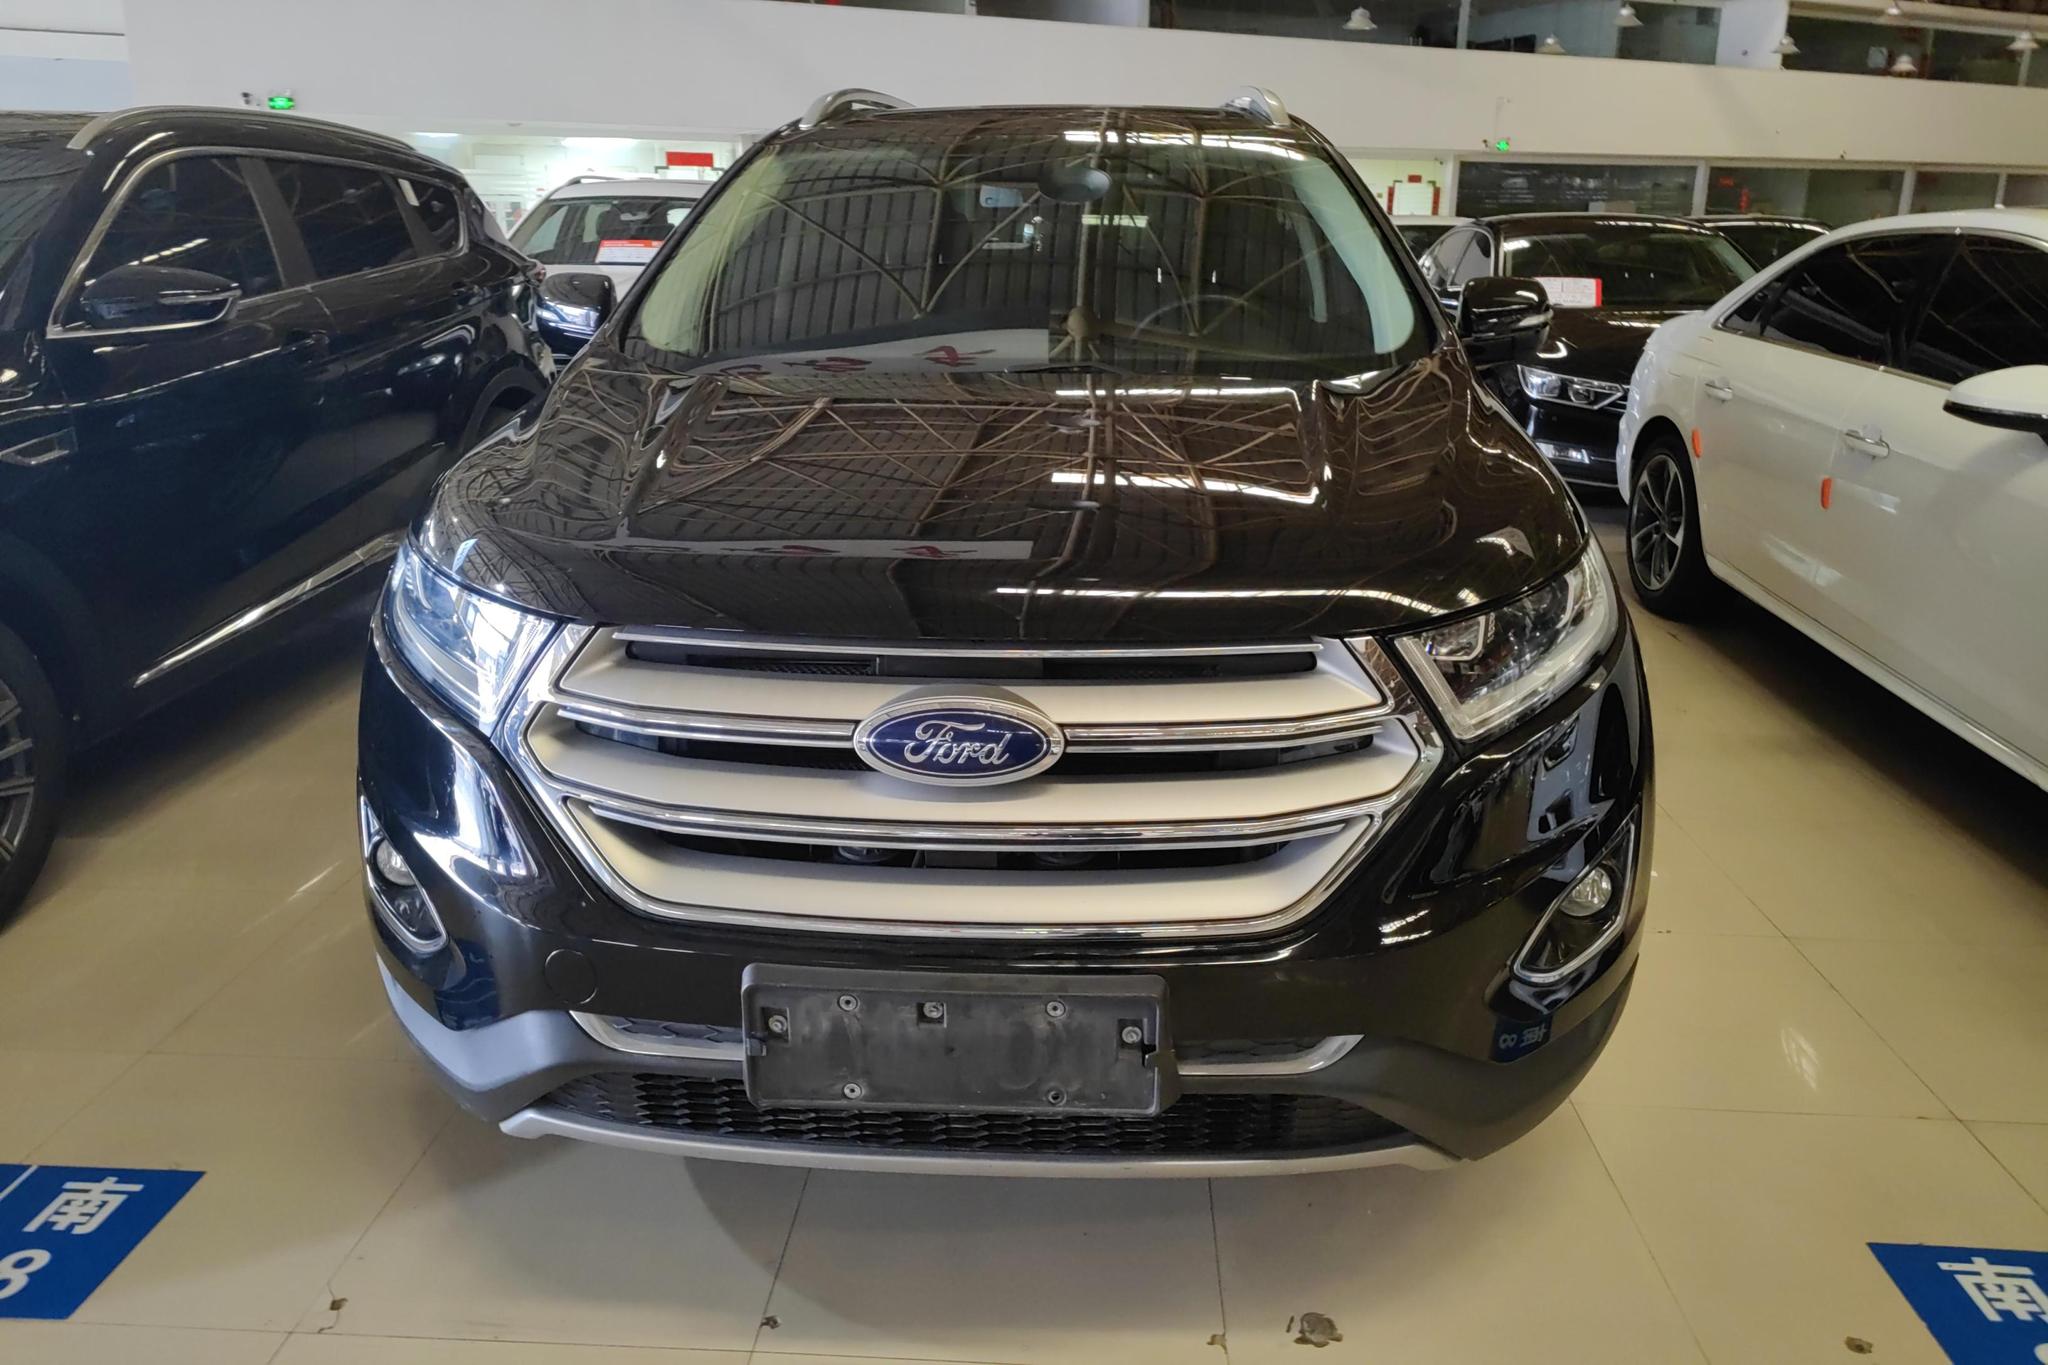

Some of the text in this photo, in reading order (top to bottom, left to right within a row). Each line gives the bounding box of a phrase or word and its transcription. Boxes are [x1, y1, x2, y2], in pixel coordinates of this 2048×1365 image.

[903, 719, 1010, 766] Ford
[22, 1176, 144, 1235] 南
[1936, 1256, 2048, 1325] 南
